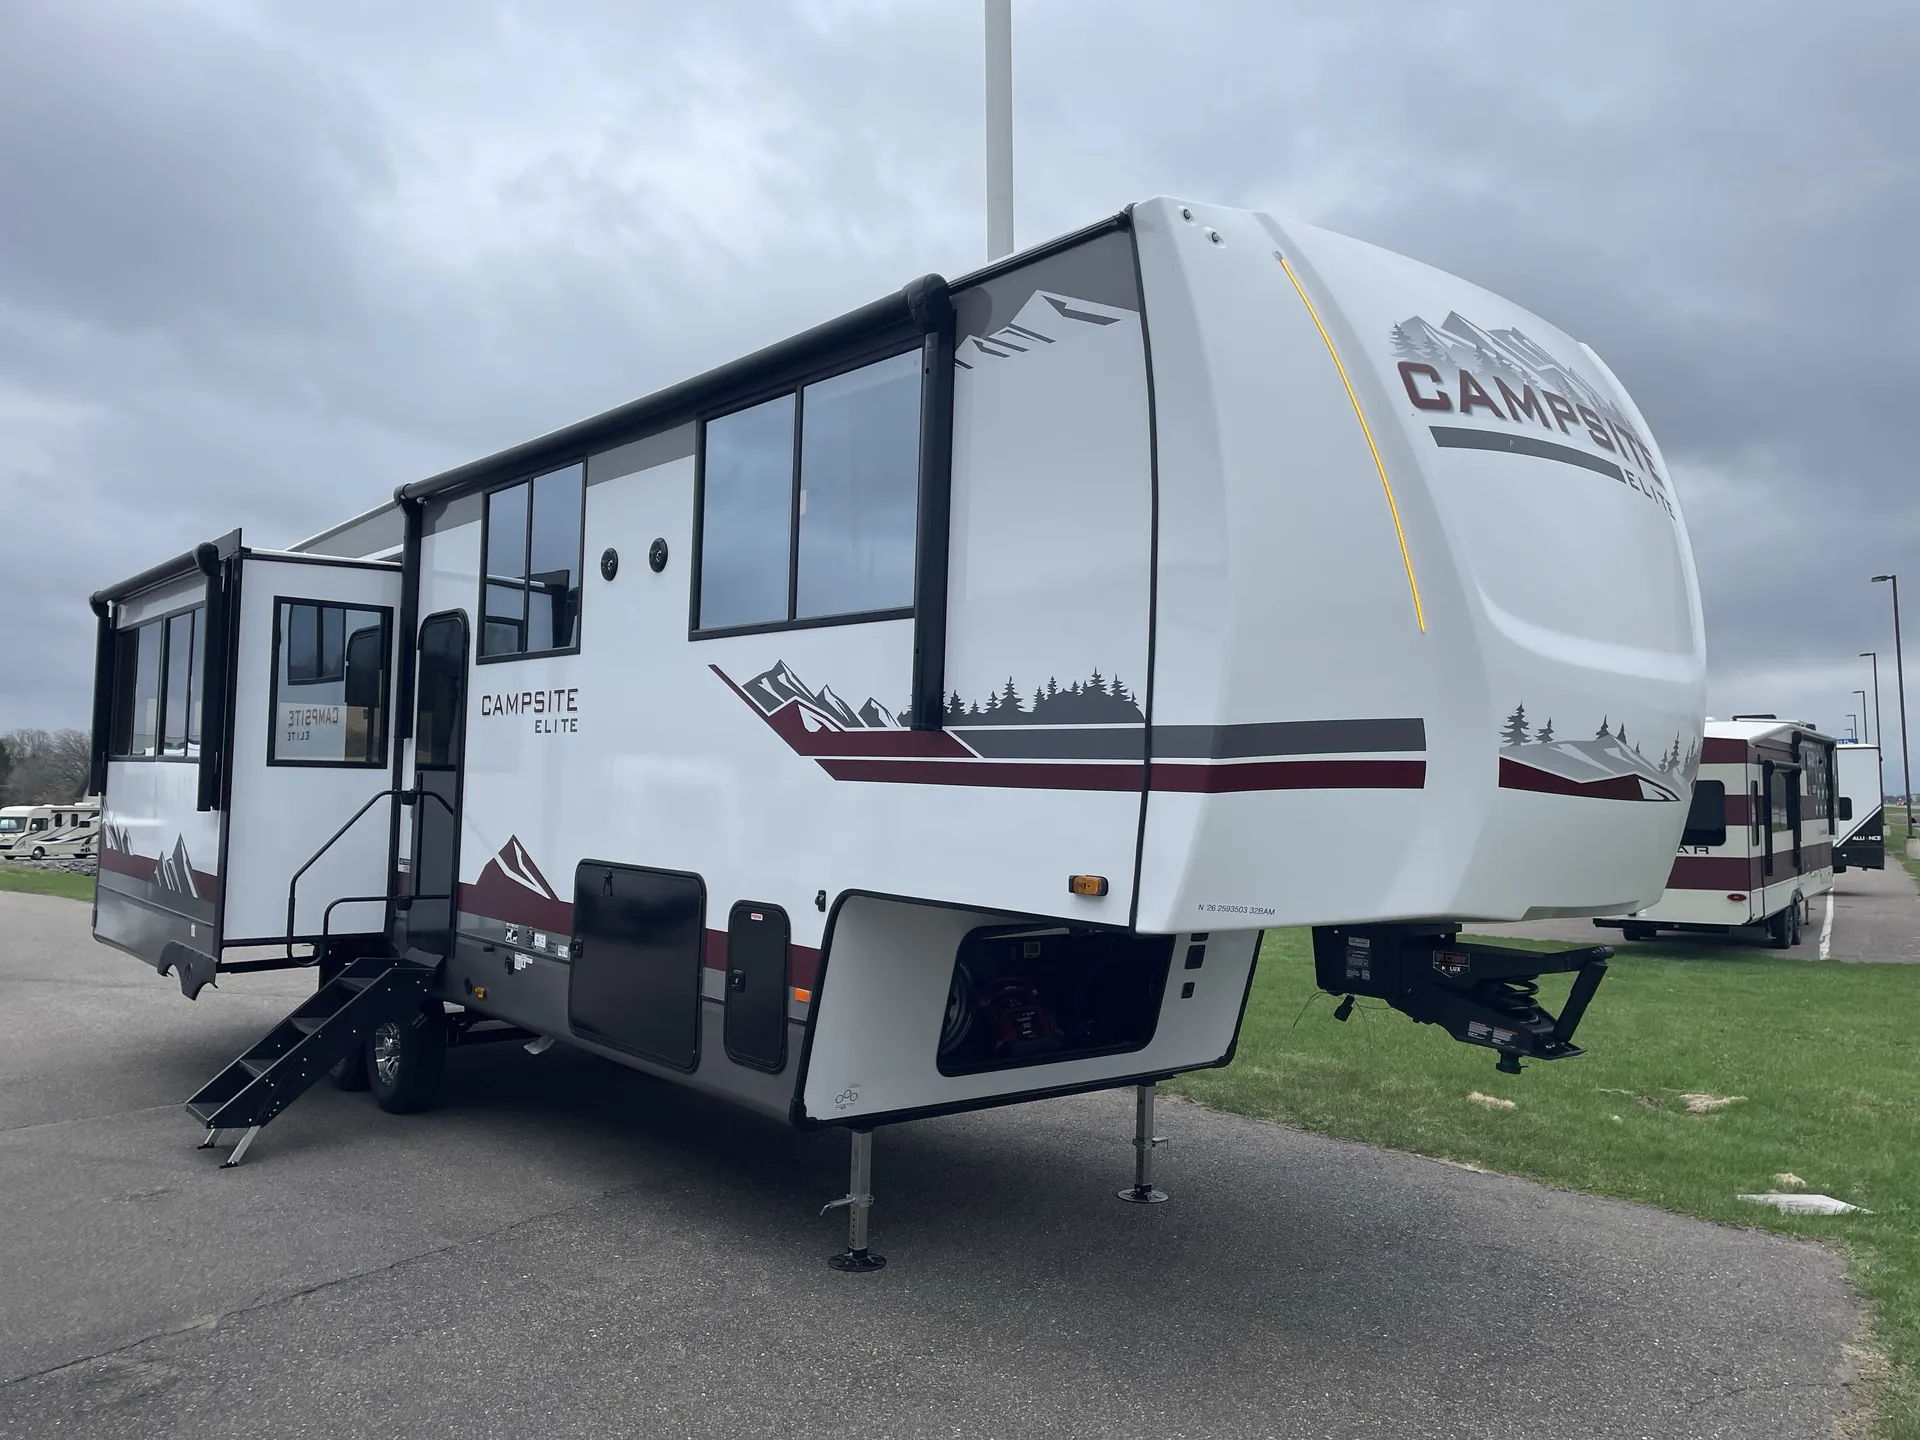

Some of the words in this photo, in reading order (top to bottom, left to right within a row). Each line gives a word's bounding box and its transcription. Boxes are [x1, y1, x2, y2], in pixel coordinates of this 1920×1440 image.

[1397, 360, 1666, 490] CAMPSITE
[1625, 468, 1677, 521] ELITE
[481, 688, 579, 716] CAMPSITE
[534, 718, 578, 734] ELITE
[1249, 906, 1276, 916] 32BAM
